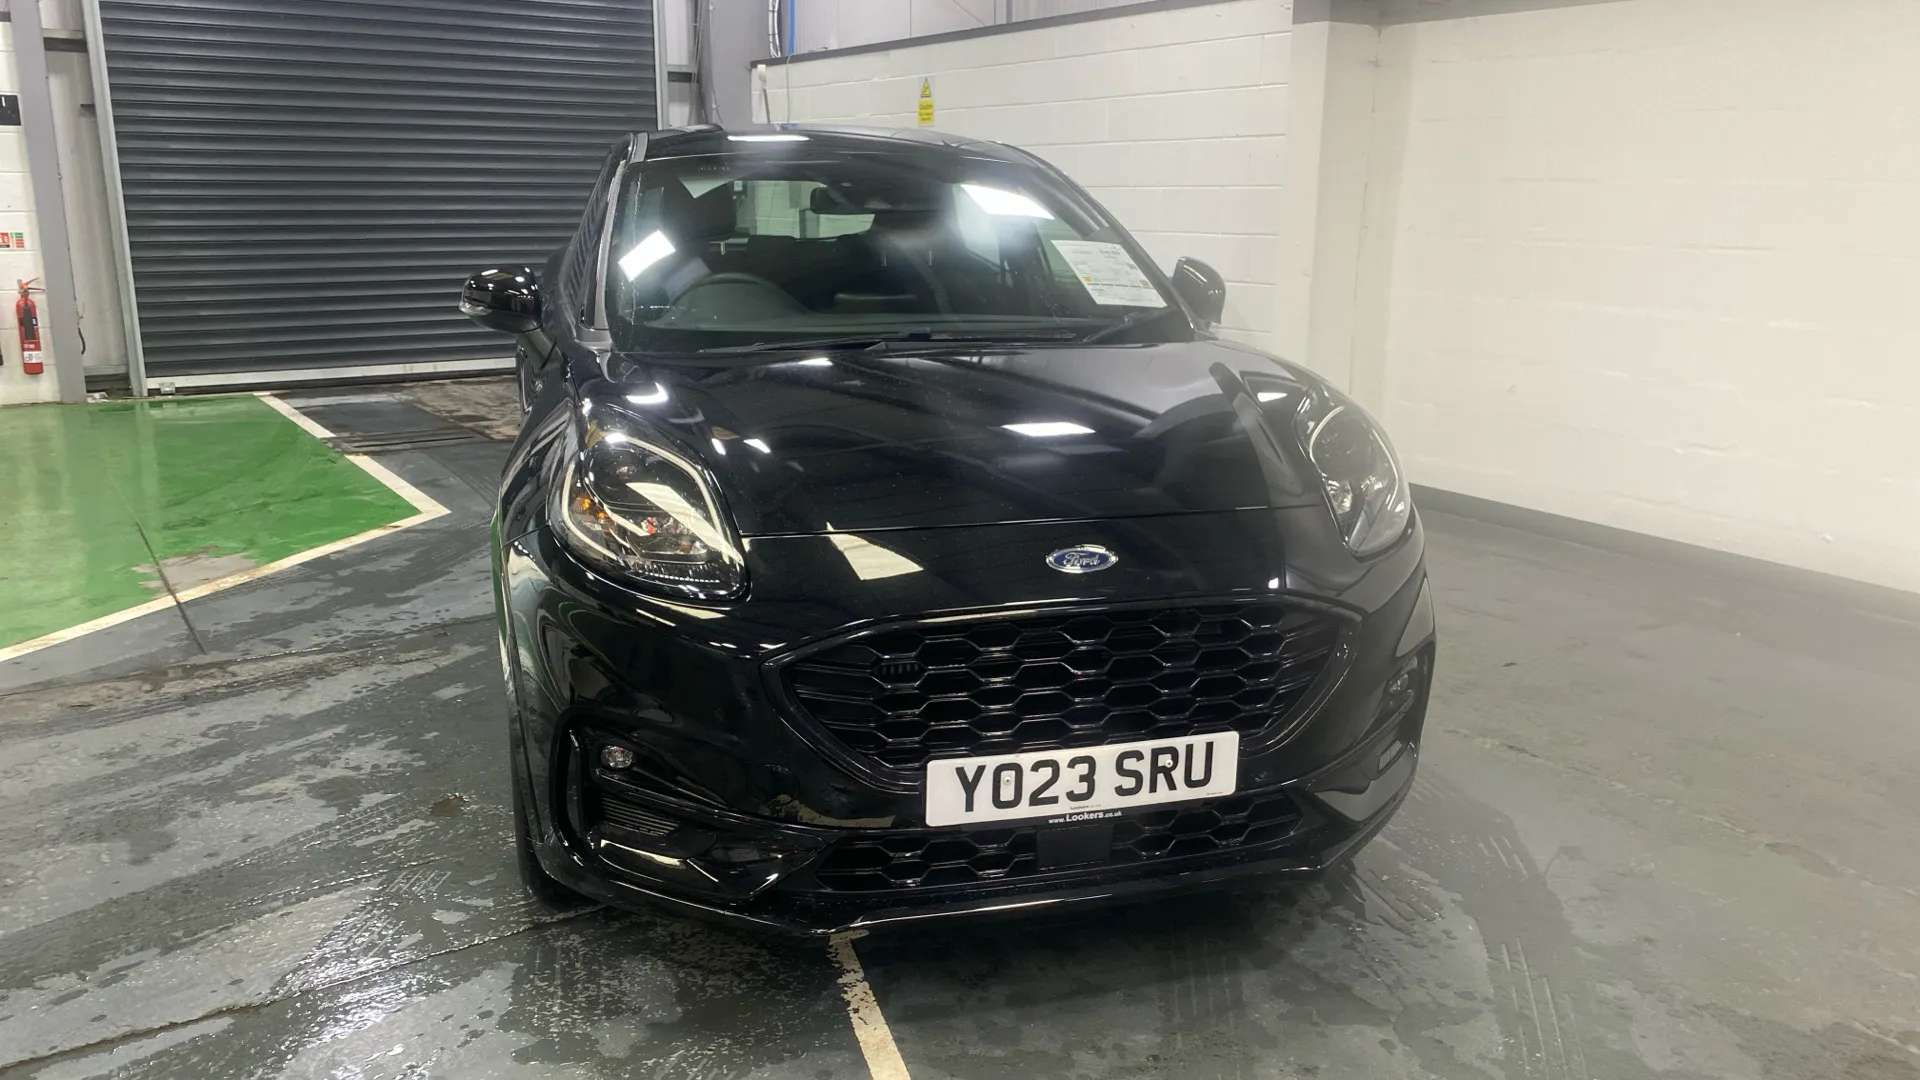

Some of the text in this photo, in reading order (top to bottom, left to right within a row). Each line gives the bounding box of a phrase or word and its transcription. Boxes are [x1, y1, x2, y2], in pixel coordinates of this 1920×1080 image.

[1062, 551, 1101, 567] Ford
[955, 741, 1214, 813] YO23 SRU
[1048, 811, 1122, 824] www.Lookers.co.uk
